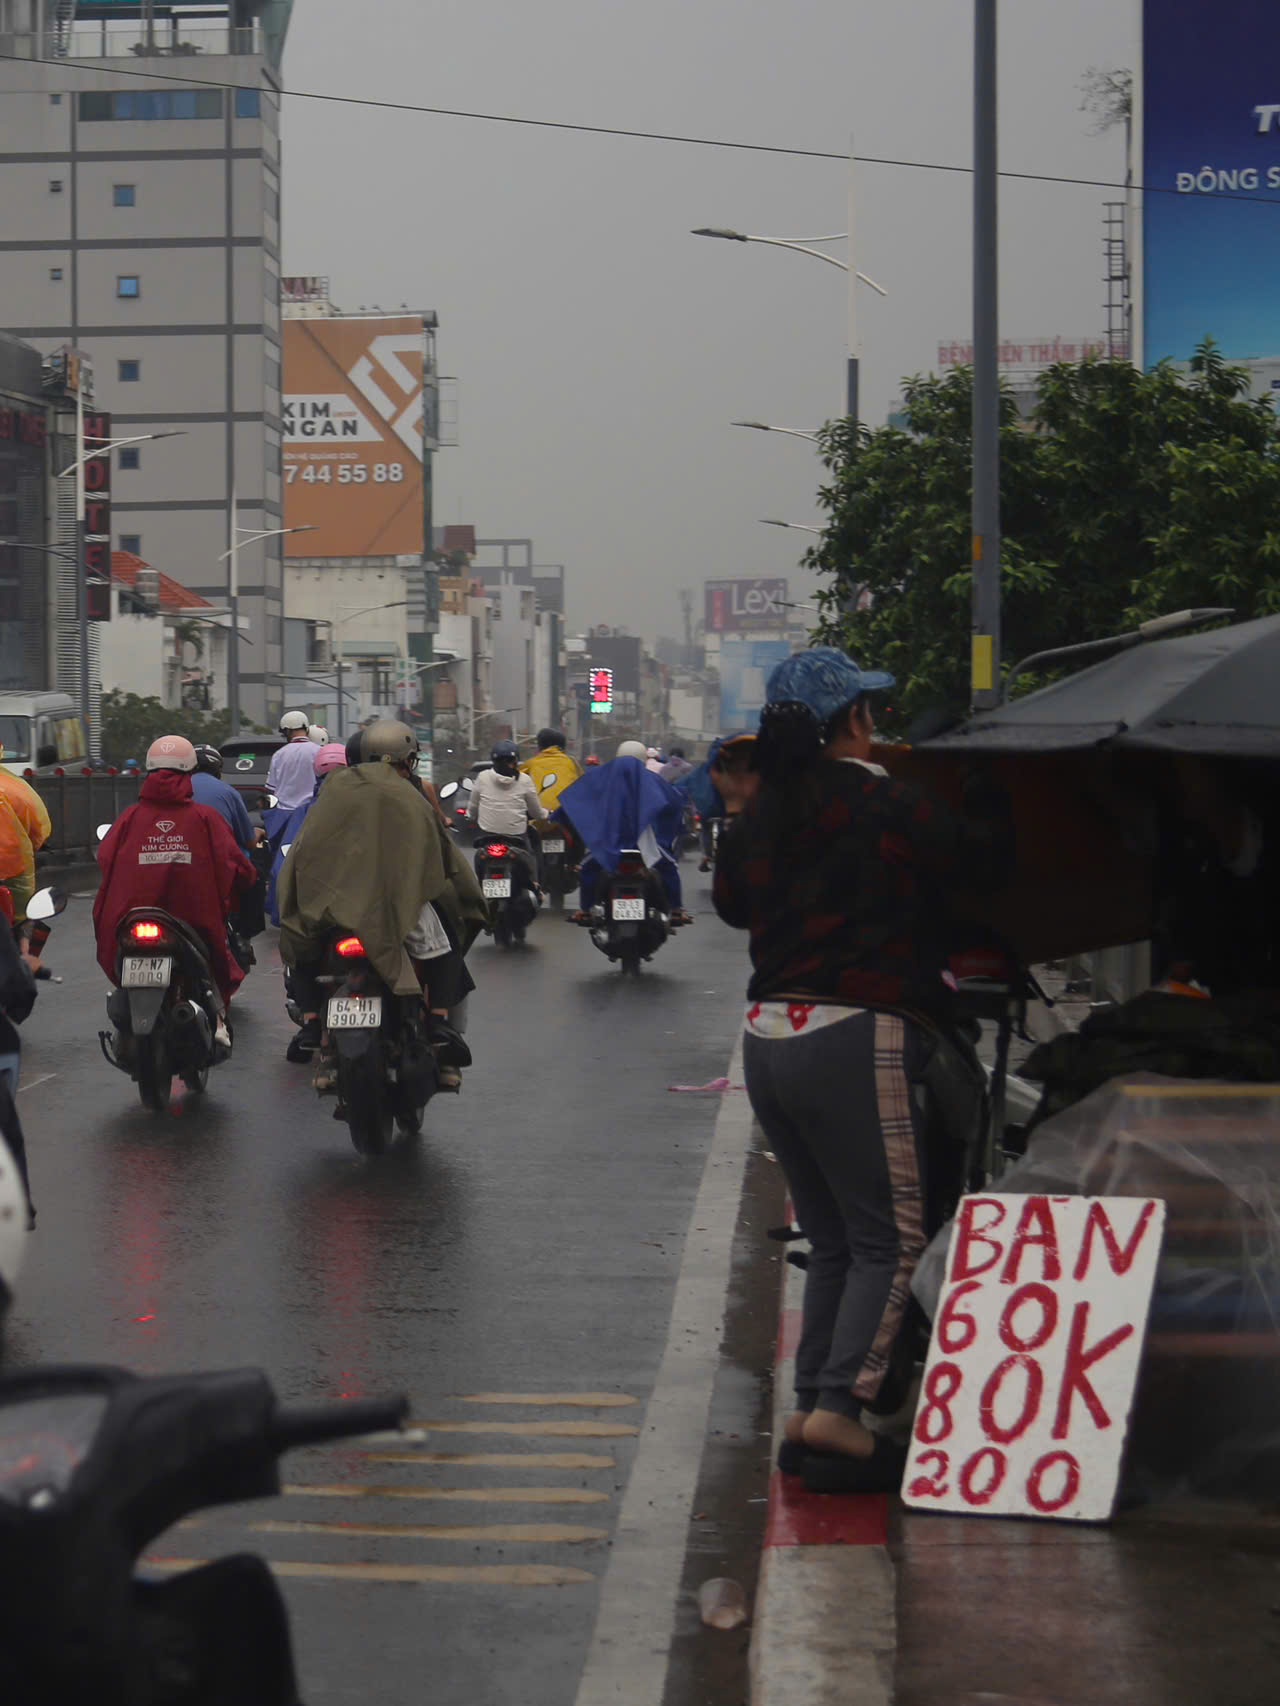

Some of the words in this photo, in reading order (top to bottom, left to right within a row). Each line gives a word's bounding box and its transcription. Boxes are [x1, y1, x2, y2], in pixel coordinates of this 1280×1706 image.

[1176, 165, 1259, 193] ĐÔNG
[83, 416, 105, 617] HOTEL
[331, 1012, 376, 1026] 390.78
[336, 1000, 373, 1012] 64-H1
[907, 1447, 1081, 1512] 200
